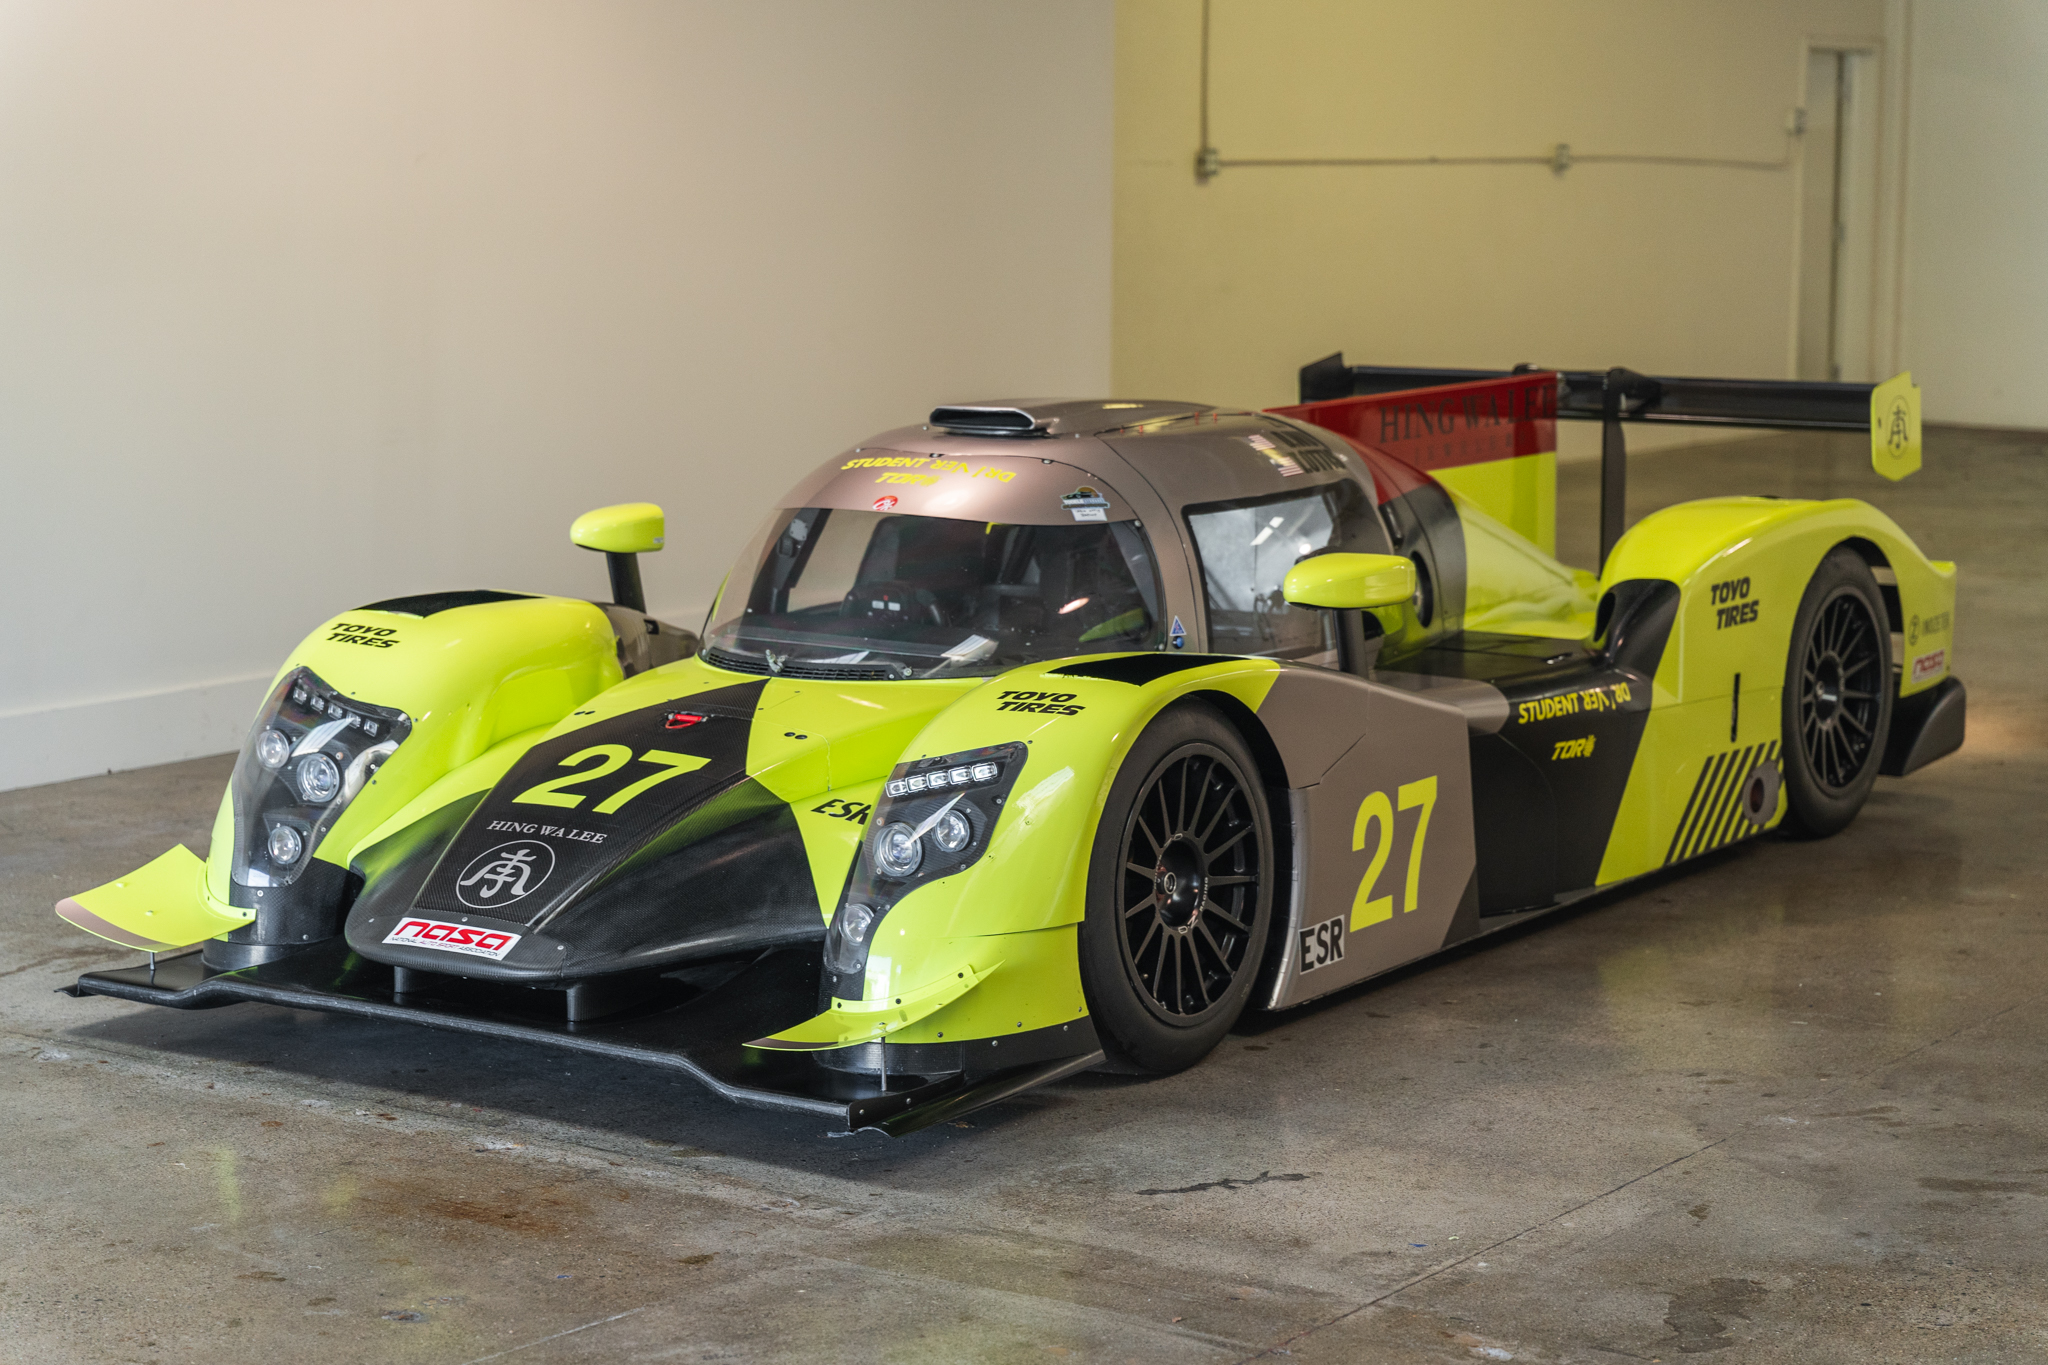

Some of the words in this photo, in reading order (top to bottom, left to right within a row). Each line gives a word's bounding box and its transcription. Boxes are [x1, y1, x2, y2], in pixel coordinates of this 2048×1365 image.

[840, 456, 931, 471] STUDENT
[930, 459, 1017, 484] DRIVER
[1711, 576, 1752, 606] TOYO
[330, 622, 397, 637] TOYO
[1716, 600, 1760, 630] TIRES
[326, 632, 400, 649] TIRES
[996, 701, 1086, 717] TIRES
[997, 690, 1077, 703] TOYO
[1518, 692, 1579, 725] STUDENT
[512, 743, 712, 815] 27
[486, 820, 538, 834] HING
[540, 825, 565, 838] WA
[566, 829, 608, 844] LEE
[1349, 775, 1438, 933] 27
[1299, 917, 1343, 973] ESR
